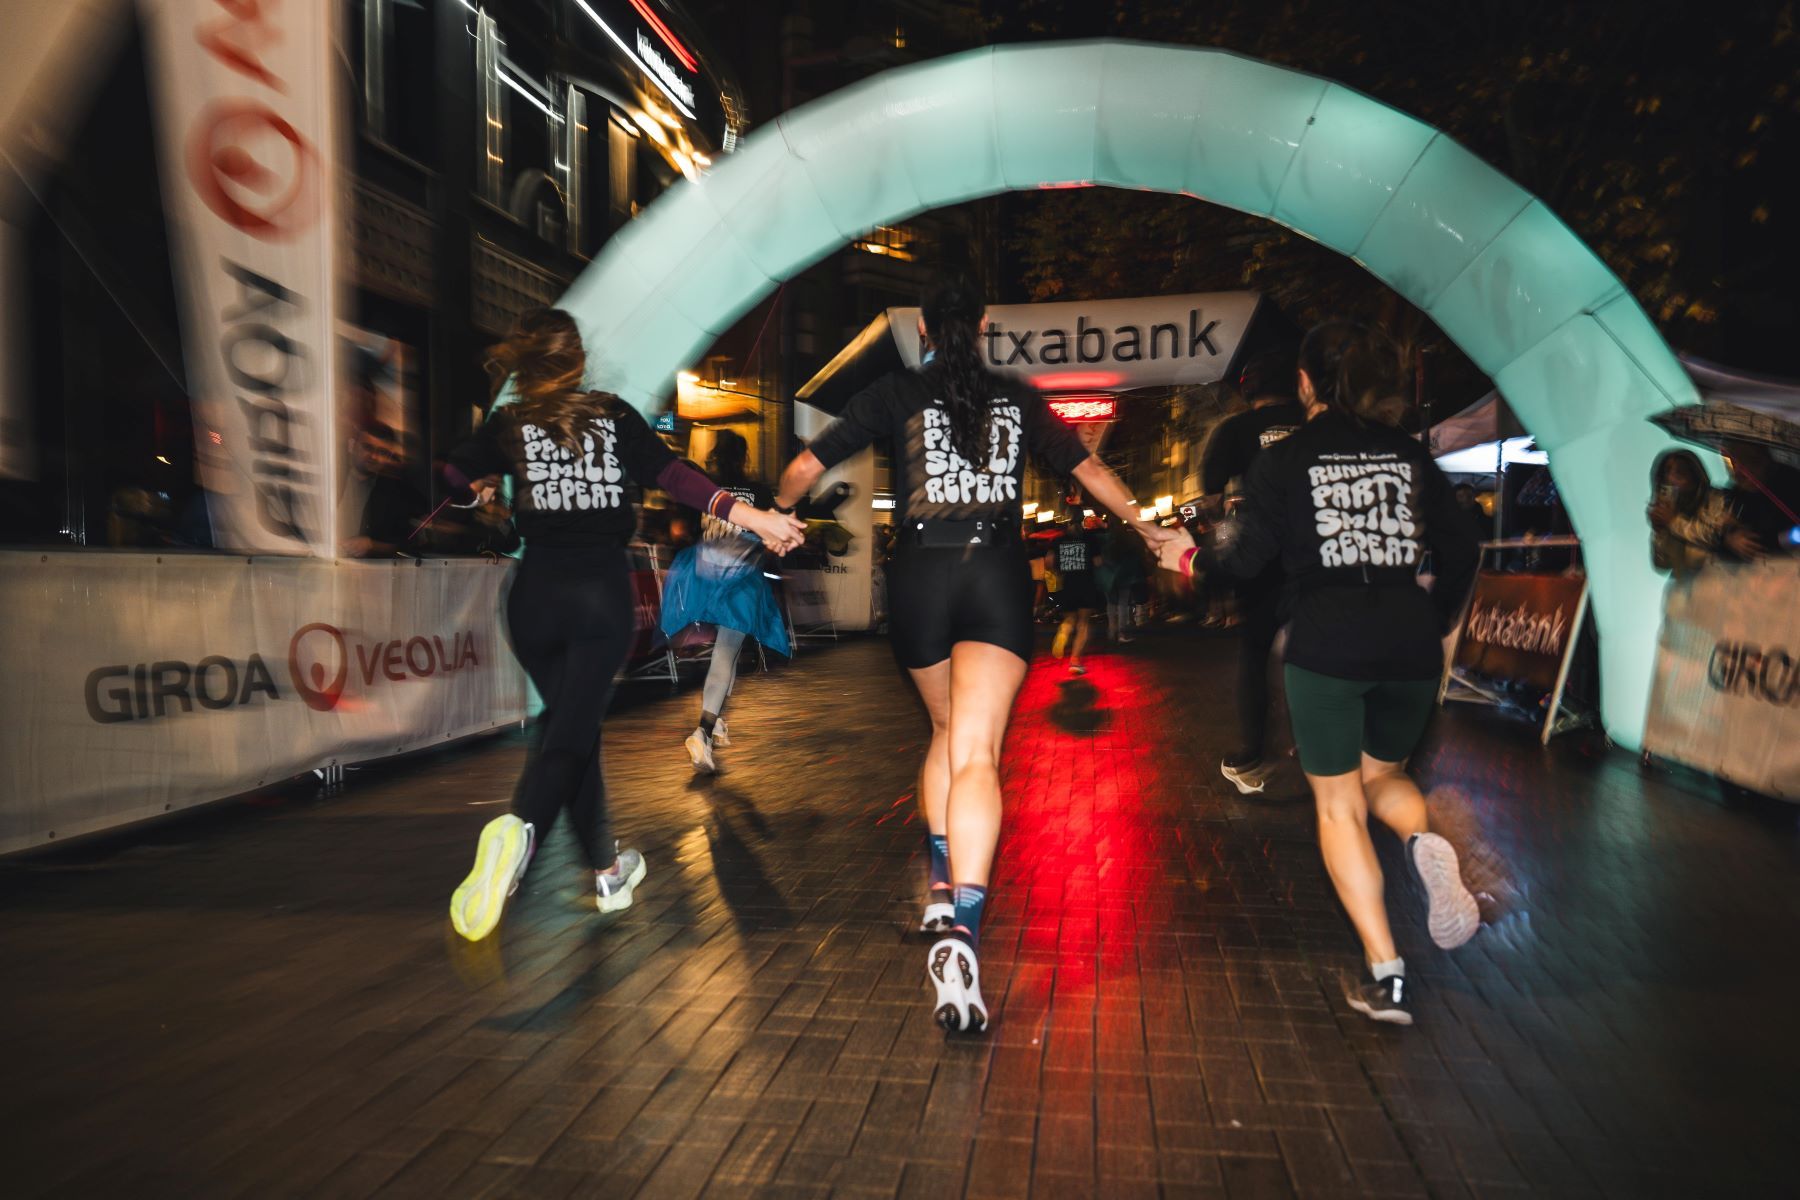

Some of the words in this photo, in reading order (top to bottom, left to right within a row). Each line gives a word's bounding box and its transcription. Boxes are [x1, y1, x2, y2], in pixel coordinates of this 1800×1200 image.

[984, 308, 1220, 366] txabank
[526, 452, 622, 483] SMILE
[925, 443, 1020, 476] SMLE
[531, 478, 624, 511] REPEAT
[925, 470, 1017, 504] REPEAT
[1311, 473, 1411, 509] PARTY
[1315, 501, 1416, 537] SMILE
[1319, 529, 1418, 567] REPEAT
[84, 652, 280, 724] GIROA
[356, 630, 479, 686] VEOLIA
